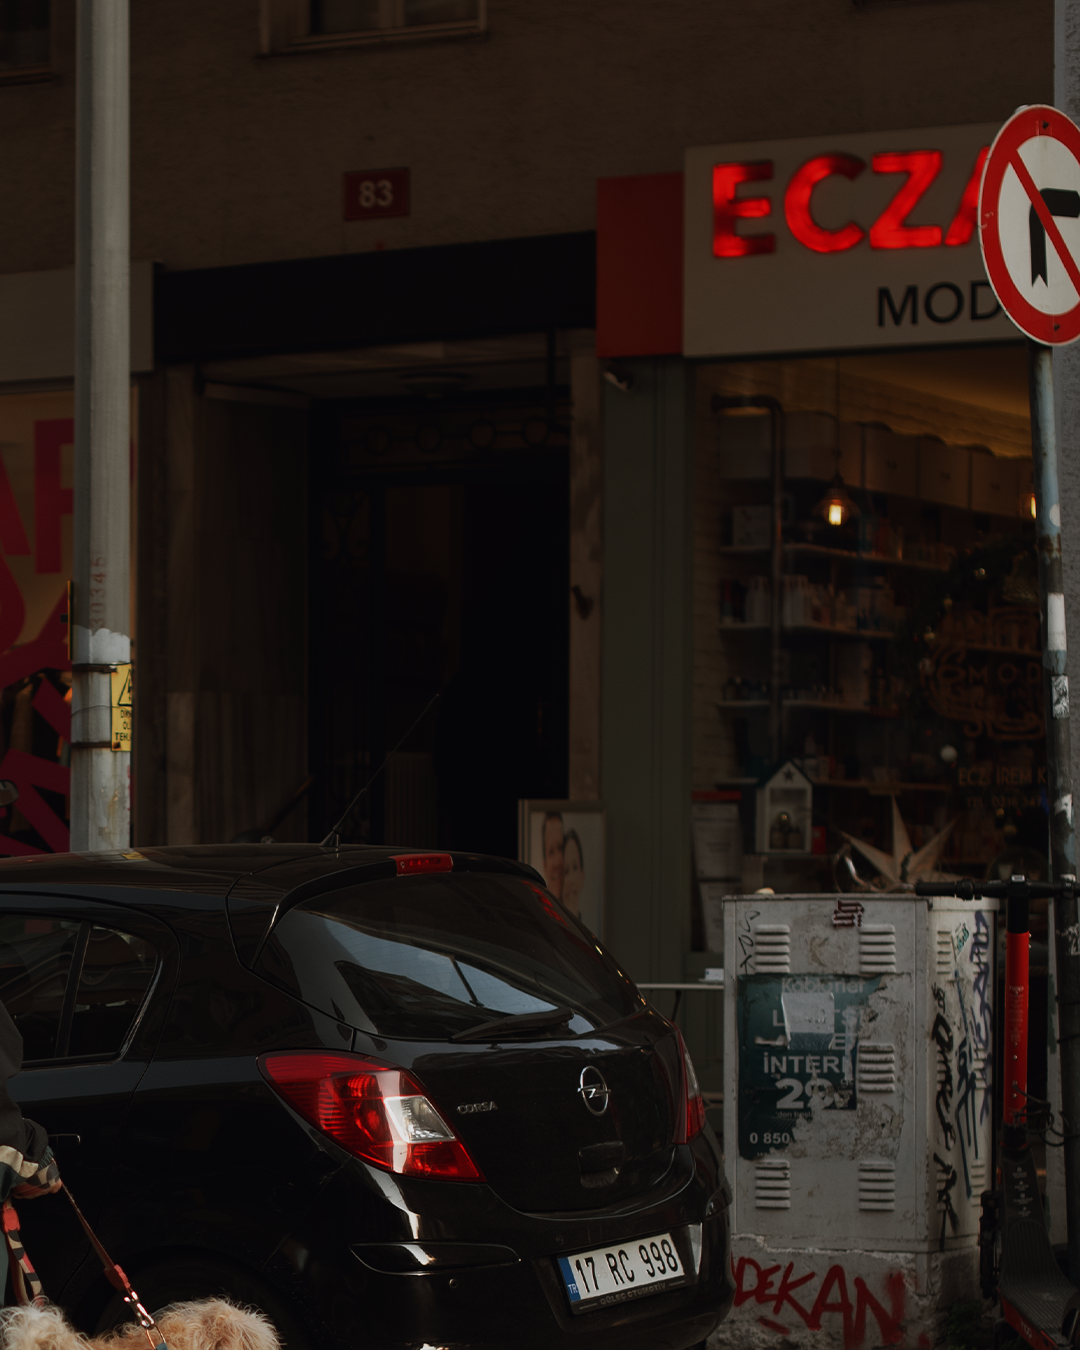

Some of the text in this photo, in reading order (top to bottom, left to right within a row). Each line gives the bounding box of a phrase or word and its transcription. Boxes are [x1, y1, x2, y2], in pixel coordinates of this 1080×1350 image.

[358, 179, 394, 208] 83
[877, 280, 1008, 327] MOD
[996, 763, 1032, 785] İREM
[456, 1101, 498, 1114] CORSA
[749, 1132, 791, 1144] 0 850
[575, 1239, 678, 1293] 17 RC 998
[567, 1283, 579, 1295] TR
